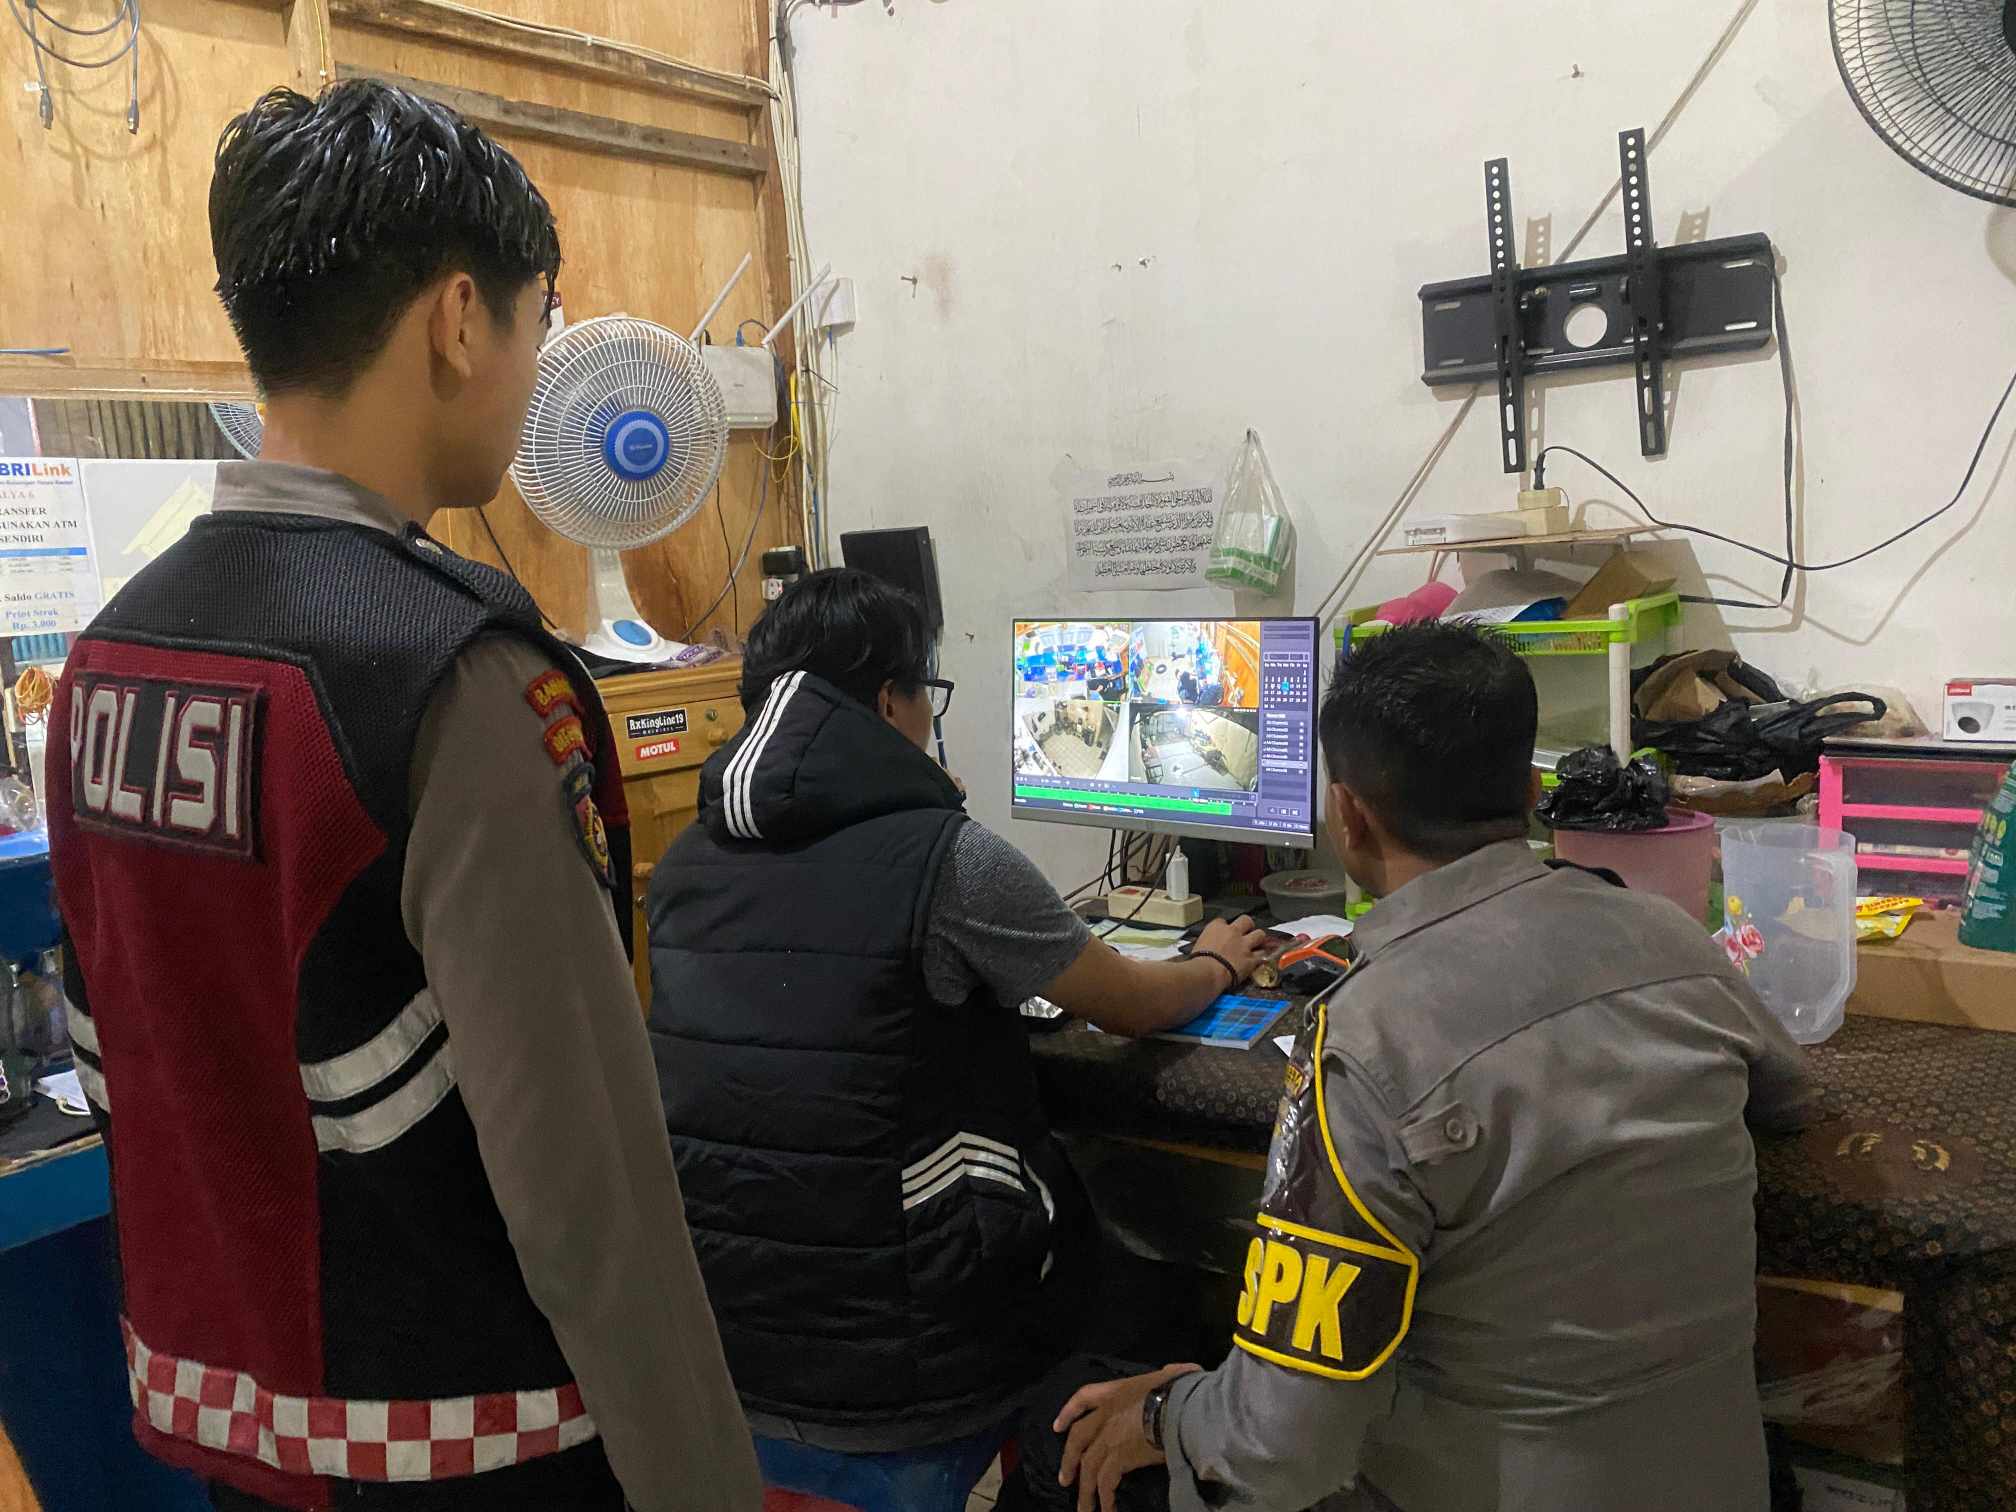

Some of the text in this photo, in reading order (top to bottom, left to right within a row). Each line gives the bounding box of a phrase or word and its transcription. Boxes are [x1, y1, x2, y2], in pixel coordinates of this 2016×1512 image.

[0, 463, 71, 476] BRILink
[52, 520, 78, 529] ATM
[4, 591, 75, 601] Saldo GRATIS
[640, 741, 676, 758] MOTUL
[70, 686, 243, 836] POLISI
[1237, 1237, 1361, 1361] SPK
